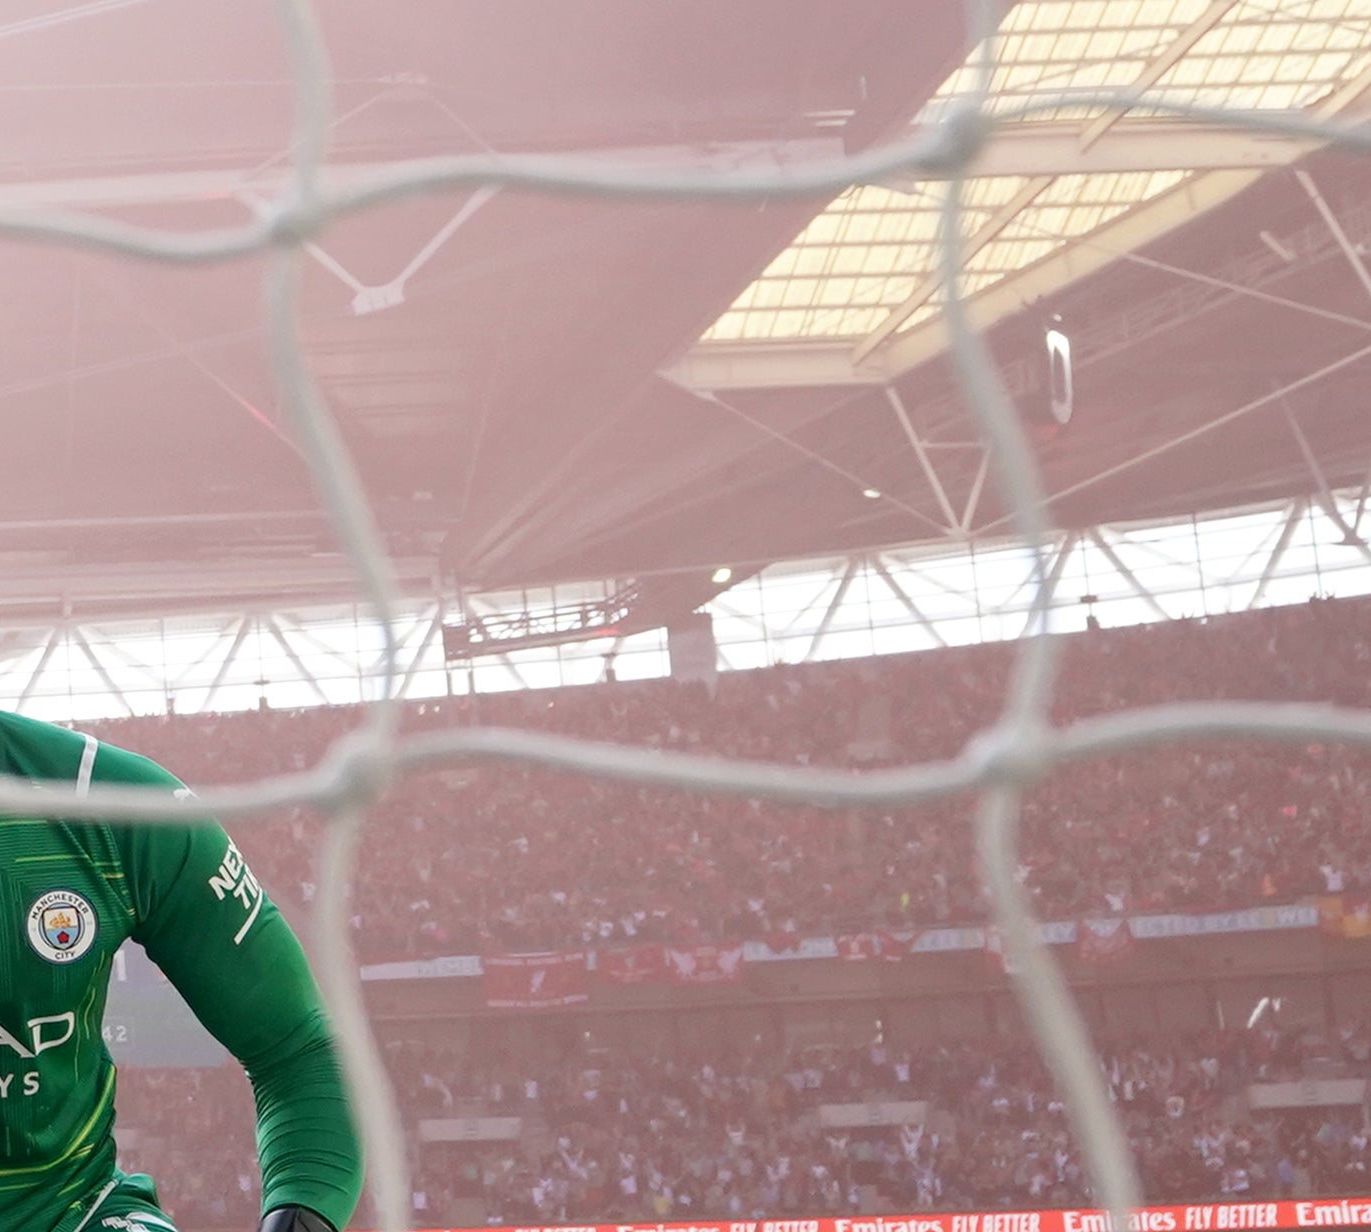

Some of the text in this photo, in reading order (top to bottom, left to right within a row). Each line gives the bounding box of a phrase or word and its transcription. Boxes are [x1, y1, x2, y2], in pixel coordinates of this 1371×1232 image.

[31, 893, 89, 920] MANCHESTER
[55, 951, 75, 960] CITY
[103, 1025, 127, 1041] 42
[1184, 1207, 1211, 1230] FLY
[1217, 1204, 1277, 1228] BETTER
[1296, 1202, 1371, 1226] Emira
